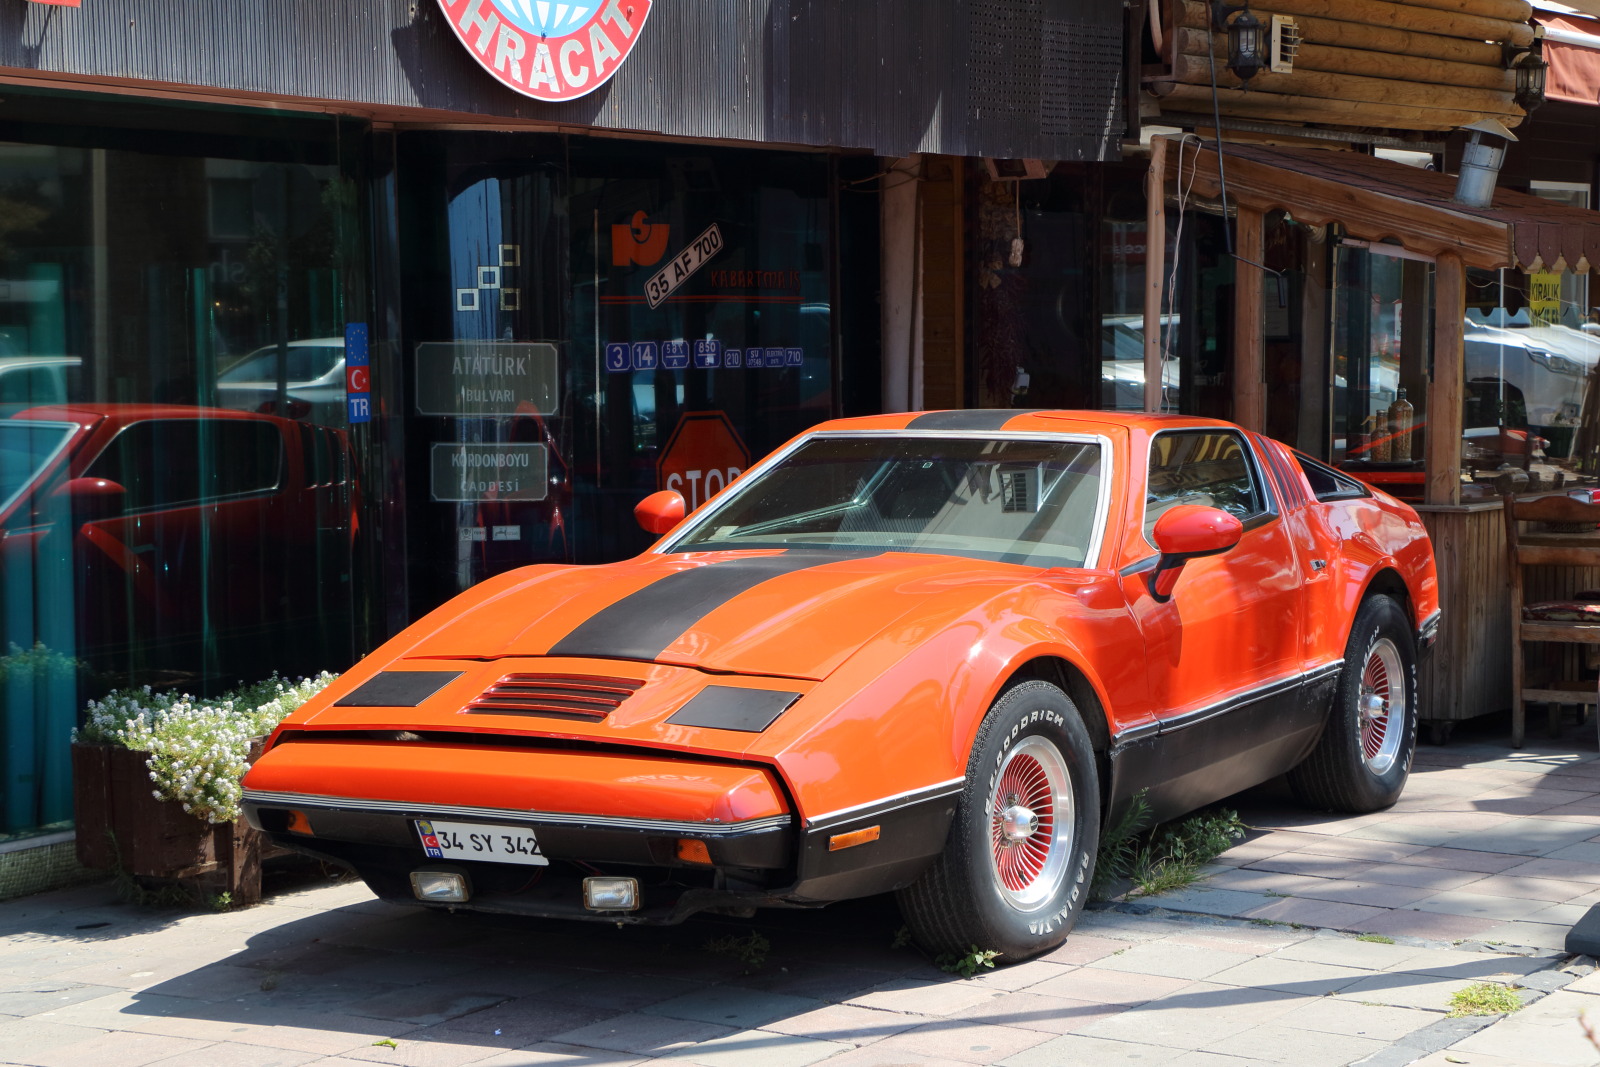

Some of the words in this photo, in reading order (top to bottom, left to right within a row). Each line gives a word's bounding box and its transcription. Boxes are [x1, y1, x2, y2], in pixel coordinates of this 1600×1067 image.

[446, 0, 634, 93] HRACAT
[650, 273, 669, 301] 35
[674, 252, 692, 282] AF
[693, 230, 719, 263] 700
[1532, 279, 1559, 301] KİRALIK
[452, 353, 527, 376] ATATÜRK
[613, 346, 623, 368] 3
[636, 345, 653, 367] 14
[726, 353, 739, 365] 210
[787, 351, 800, 362] 710
[466, 389, 515, 402] BULVARI
[351, 398, 369, 417] TR
[451, 454, 529, 468] KORDONBOYU
[460, 478, 519, 492] CADDESİ
[428, 848, 440, 856] TR
[437, 832, 464, 850] 34
[470, 833, 493, 852] SY
[501, 835, 542, 855] 342
